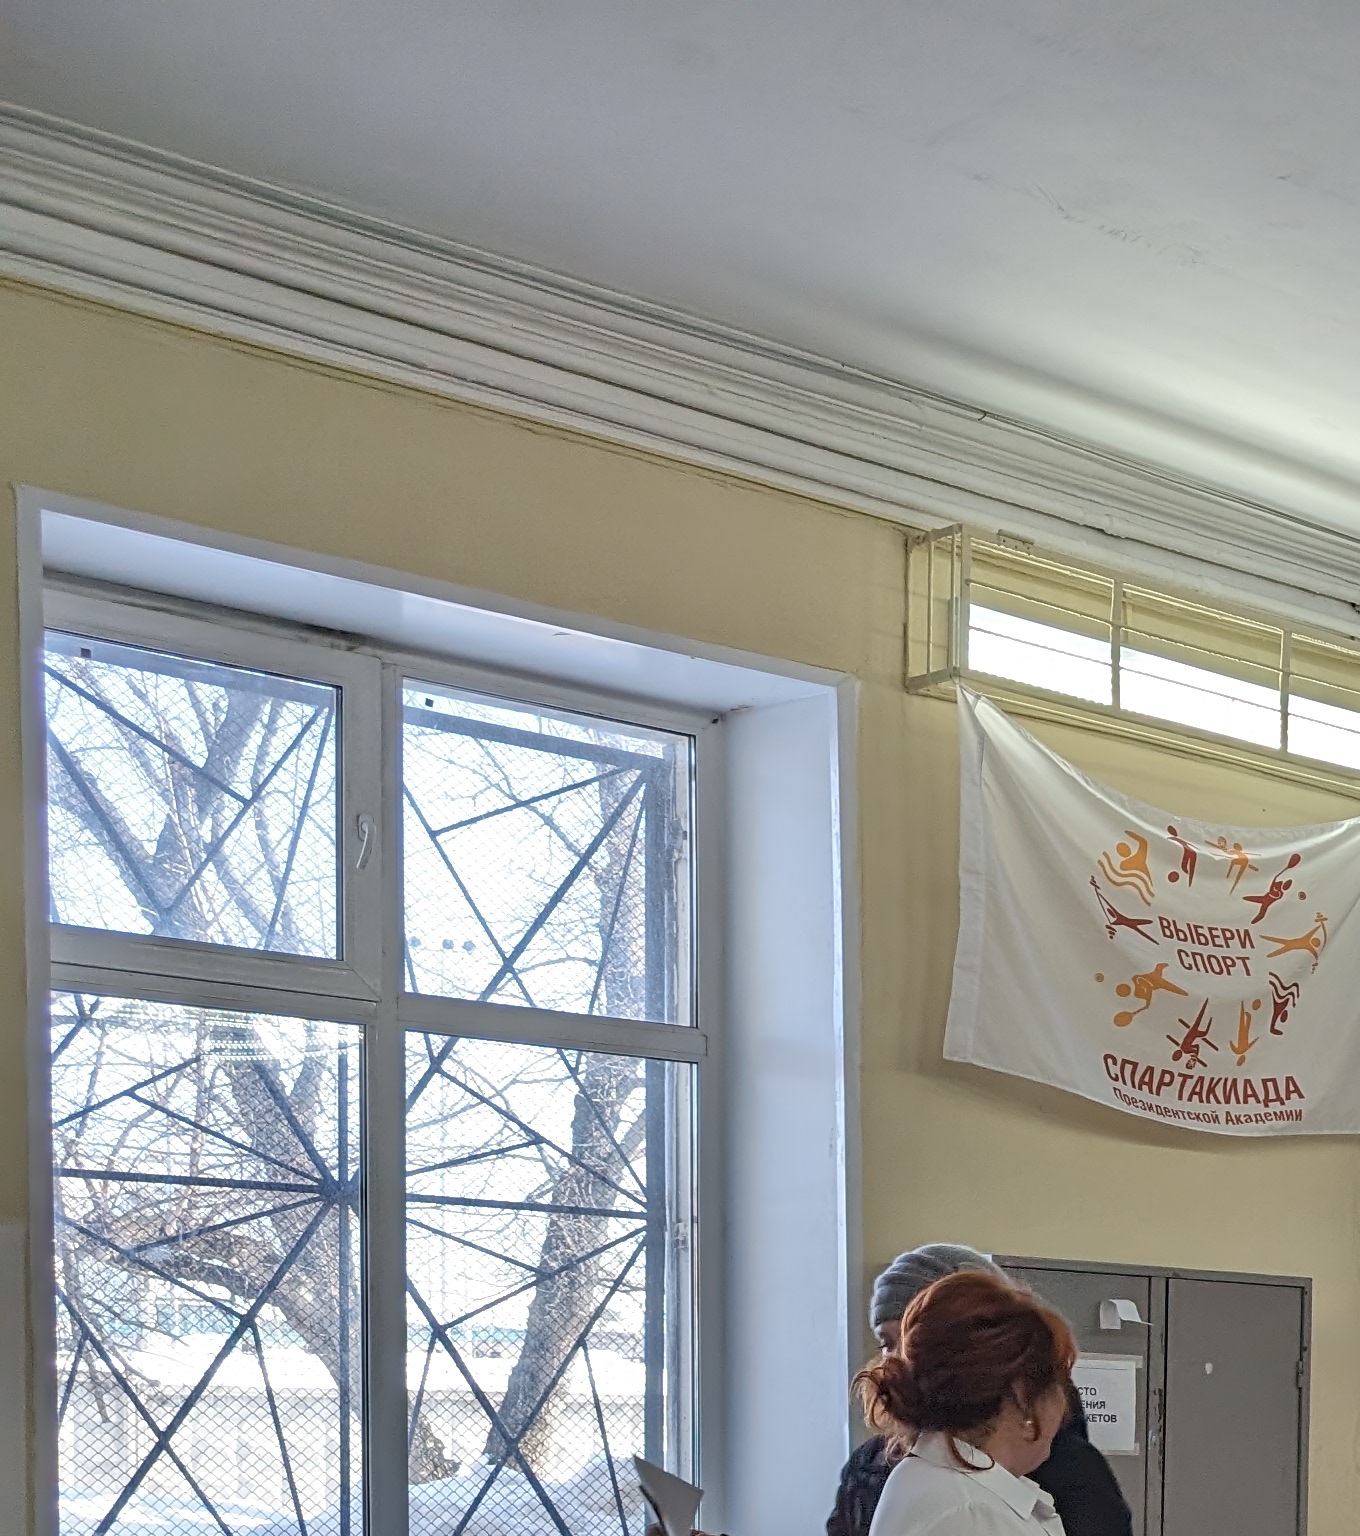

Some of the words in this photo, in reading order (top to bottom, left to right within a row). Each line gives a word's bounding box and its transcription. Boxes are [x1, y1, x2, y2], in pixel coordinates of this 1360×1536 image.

[1158, 915, 1255, 950] ВЫБЕРИ
[1176, 948, 1252, 978] СПОРТ
[1103, 1053, 1306, 1108] СПАРТАКИАДА
[1113, 1086, 1221, 1125] Президентской
[1225, 1109, 1303, 1126] Академии
[1077, 1386, 1097, 1396] СТО
[1081, 1400, 1106, 1410] ЕНИЯ
[1086, 1413, 1117, 1423] КЕТОВ
